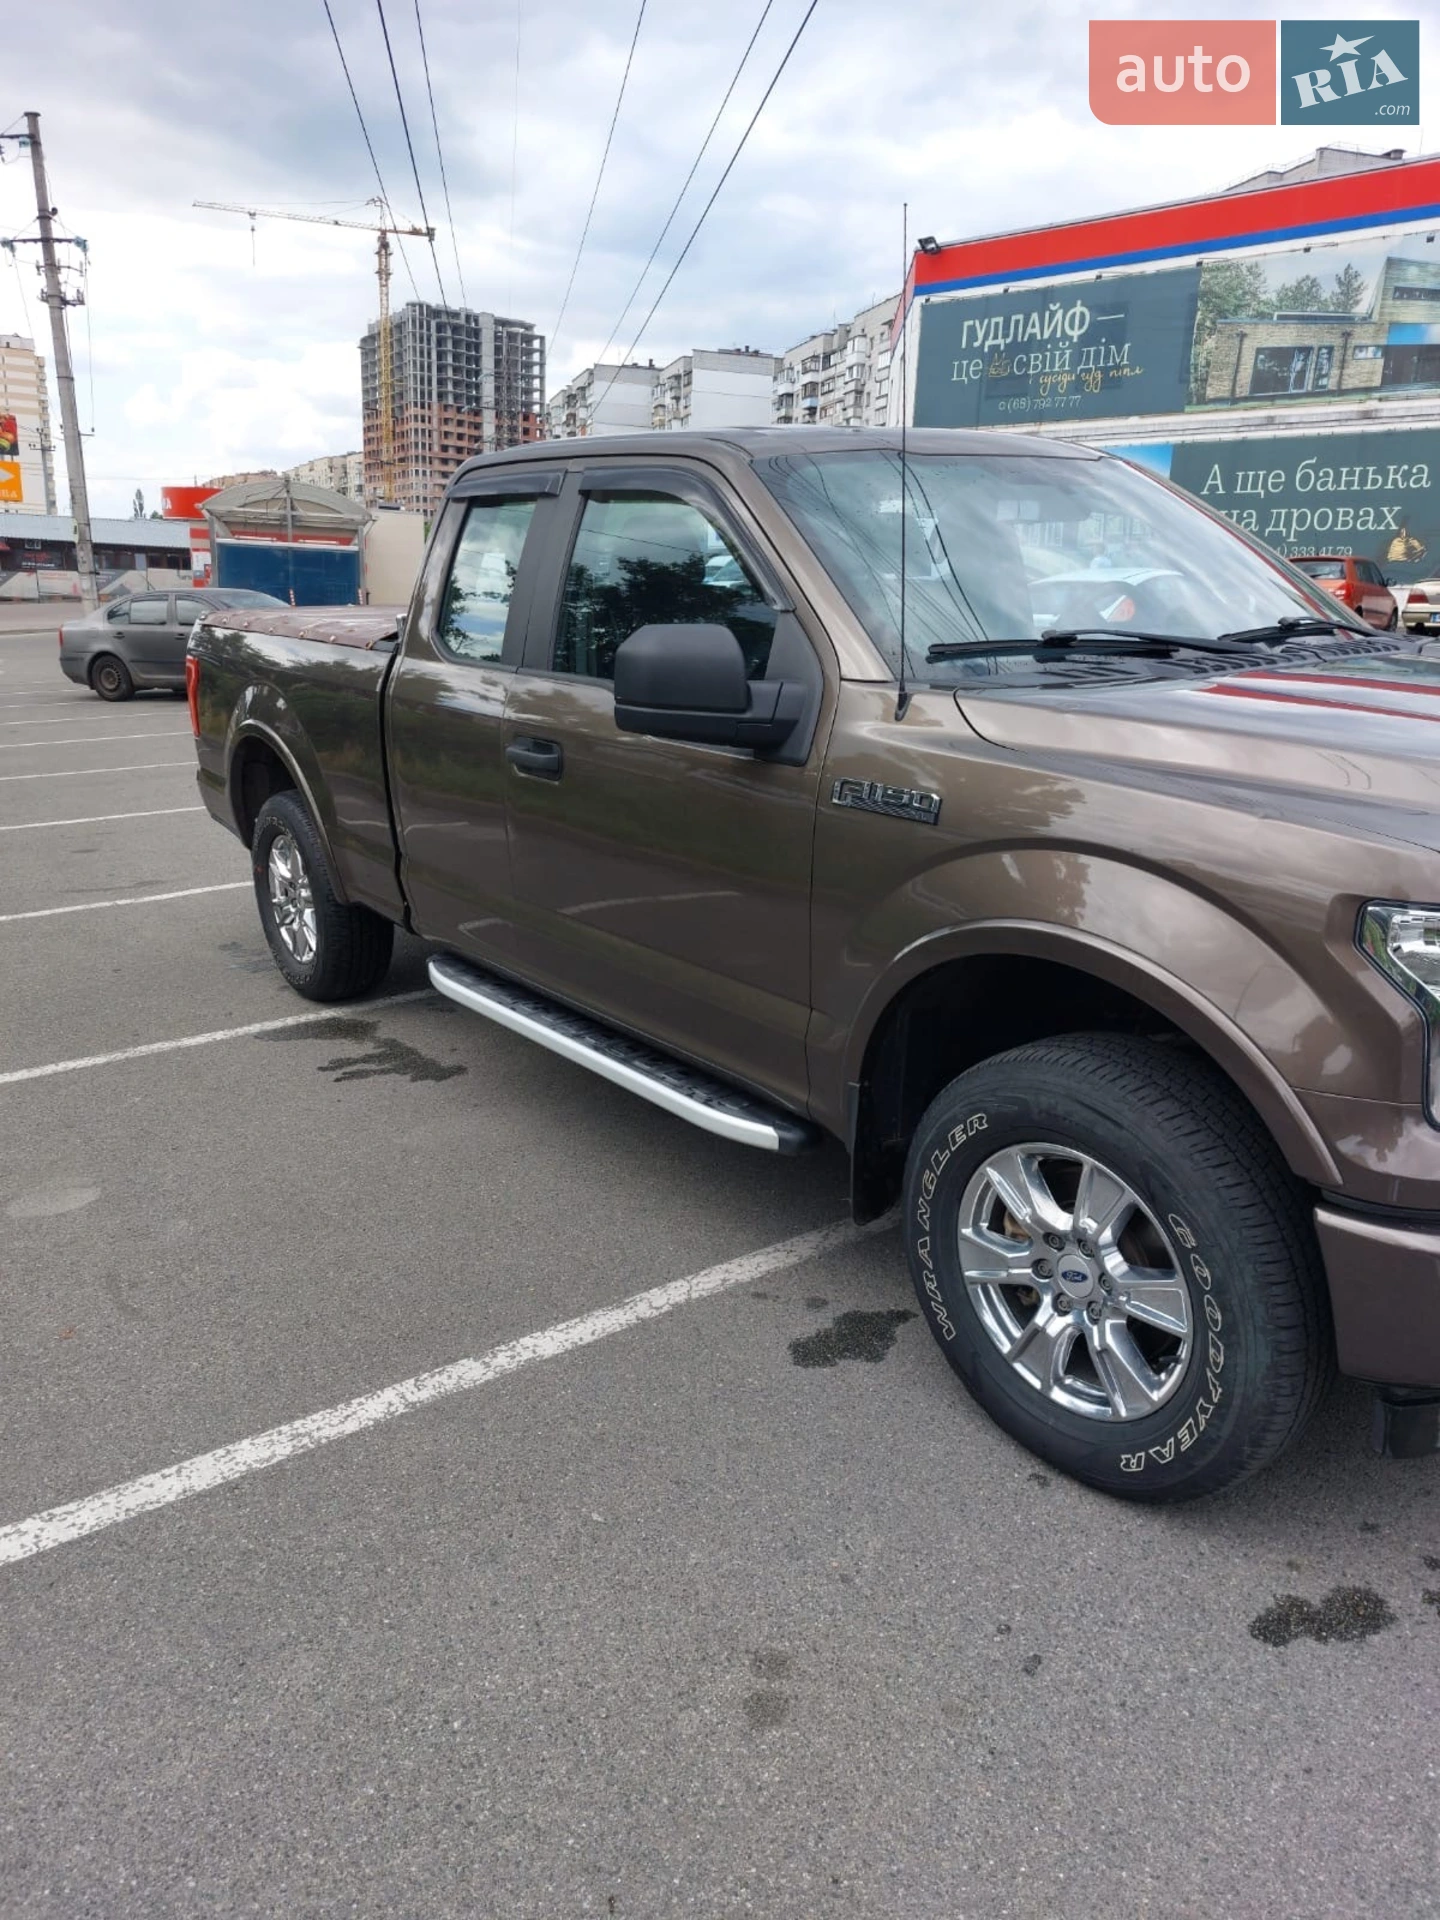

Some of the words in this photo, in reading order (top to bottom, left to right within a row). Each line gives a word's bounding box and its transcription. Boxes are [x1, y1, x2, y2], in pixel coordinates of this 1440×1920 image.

[961, 300, 1091, 352] ГУДЛАЙФ
[951, 358, 983, 384] це
[1077, 338, 1131, 375] дім
[1200, 463, 1226, 495] А
[1233, 468, 1286, 498] ще
[1295, 456, 1431, 492] банька
[1265, 506, 1402, 542] дровах
[917, 1112, 989, 1340] WRANGLER
[1120, 1213, 1224, 1472] GOODYEAR
